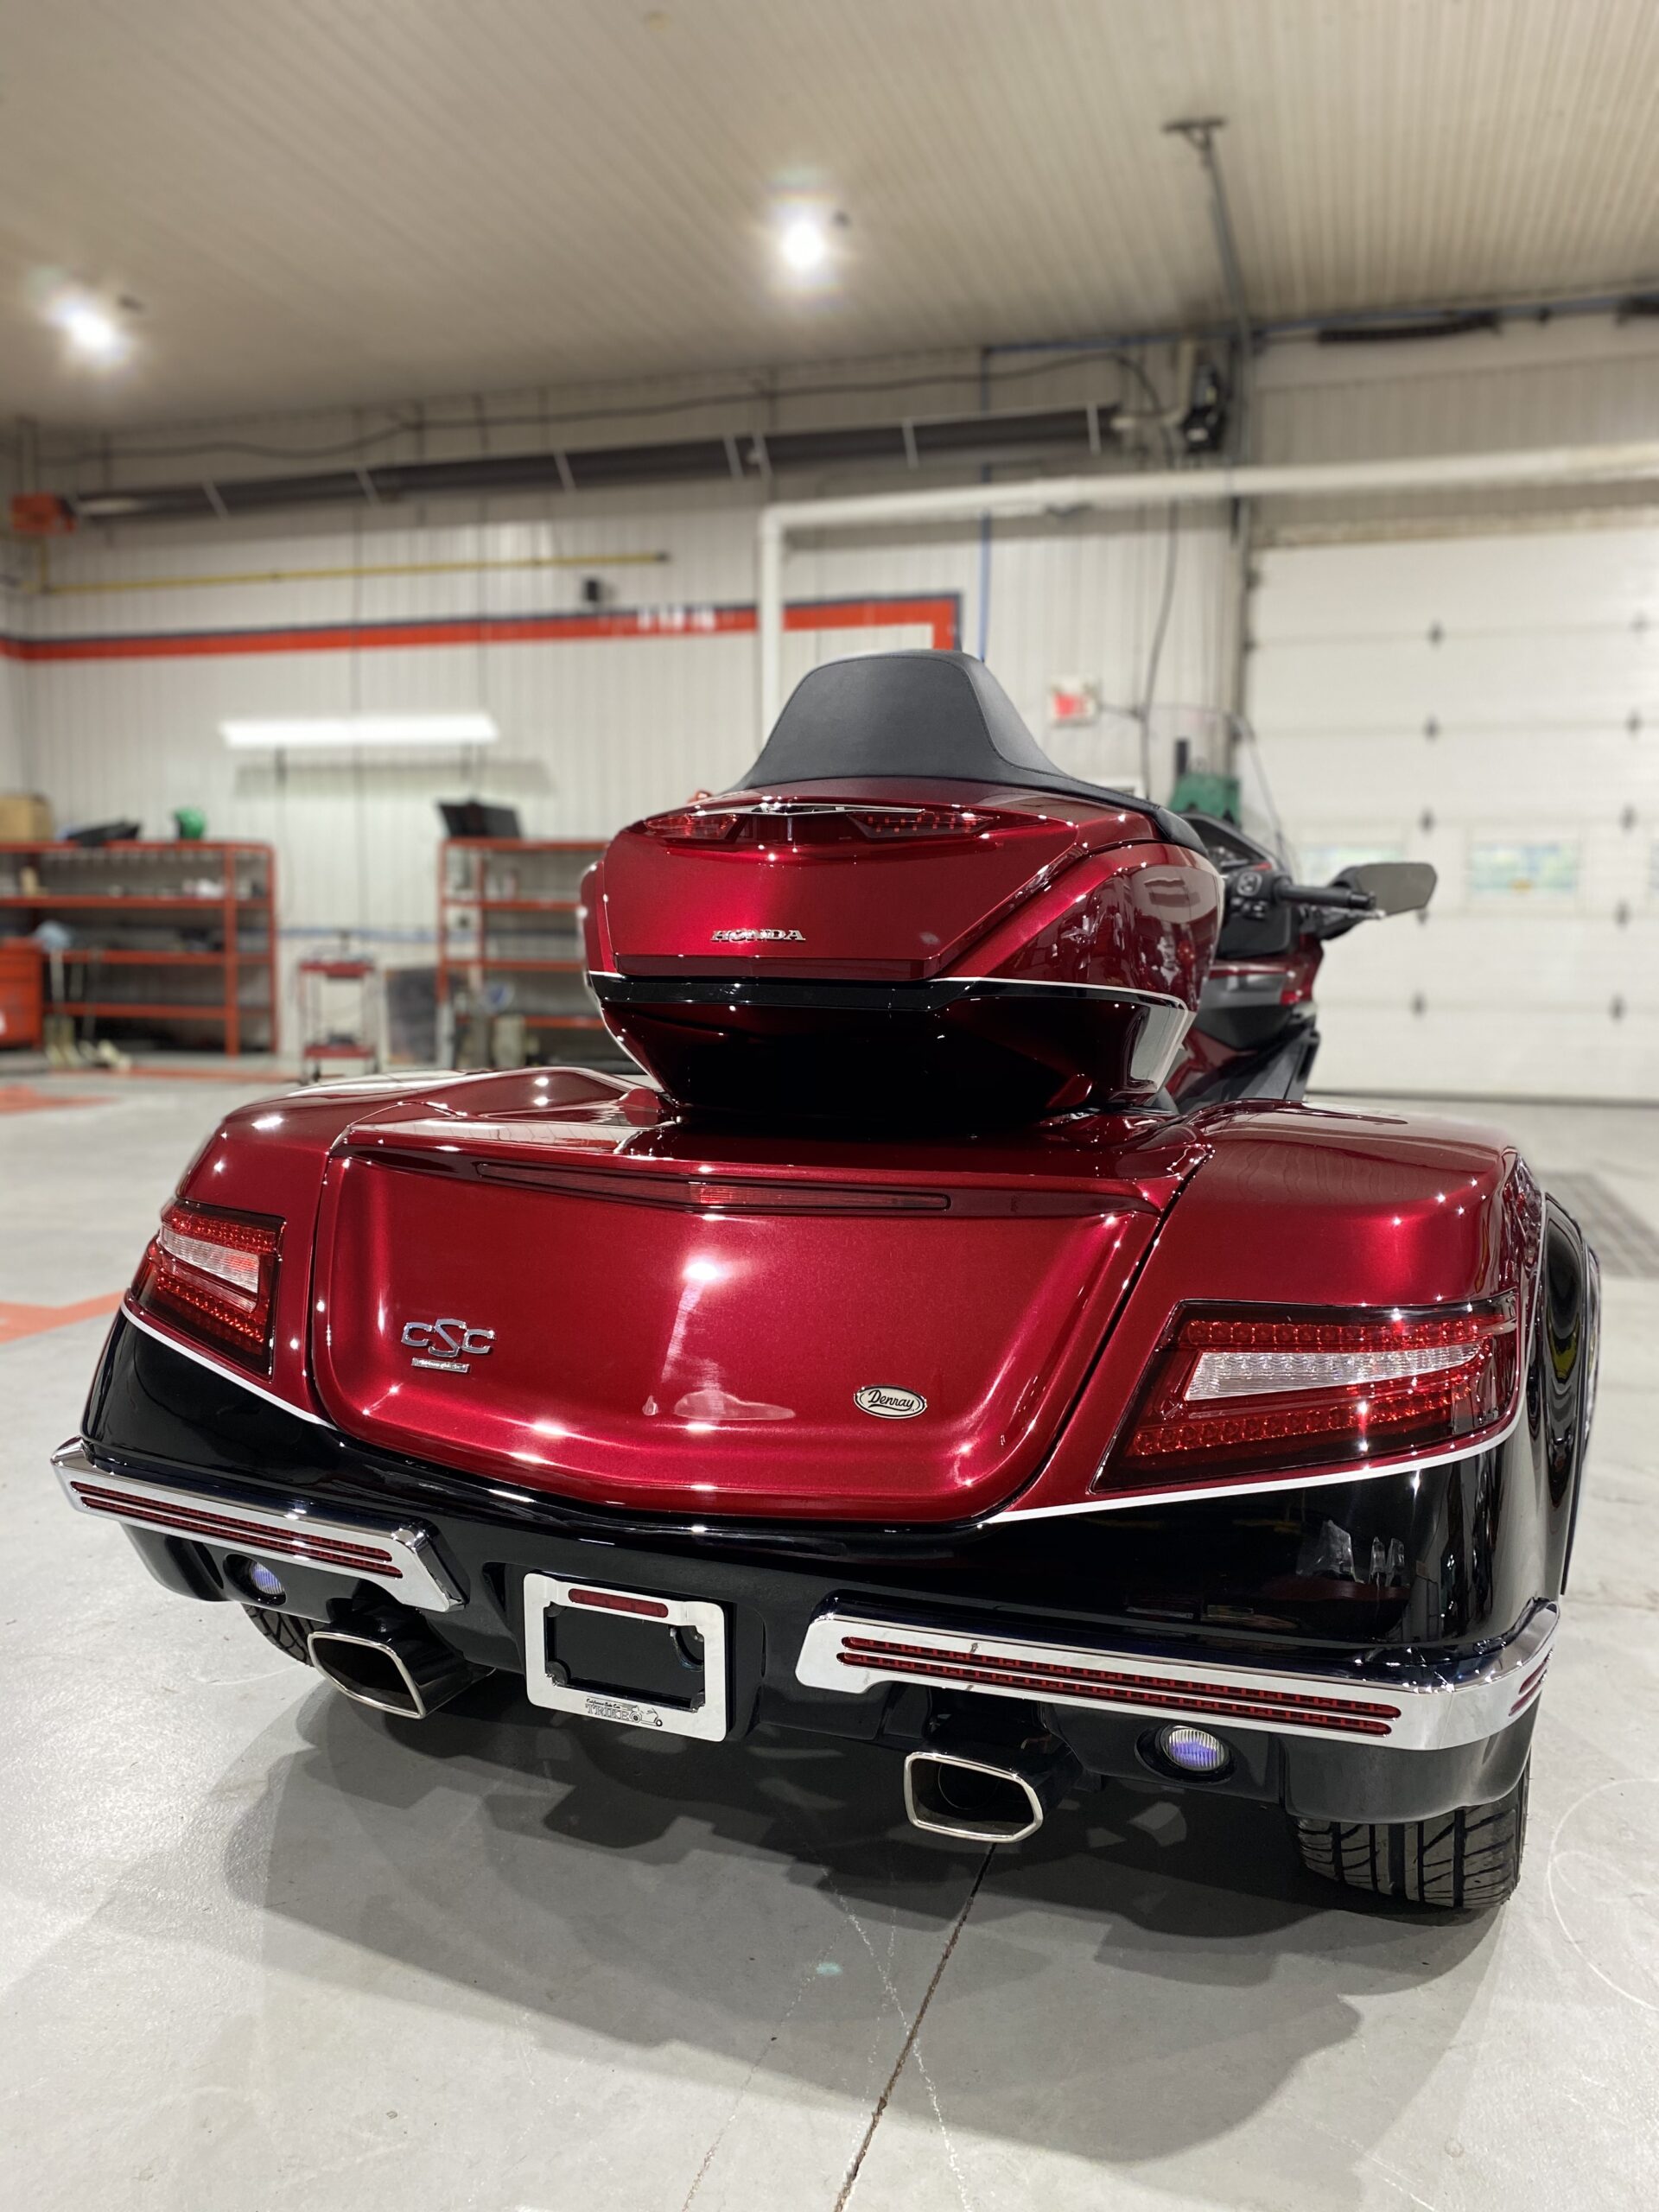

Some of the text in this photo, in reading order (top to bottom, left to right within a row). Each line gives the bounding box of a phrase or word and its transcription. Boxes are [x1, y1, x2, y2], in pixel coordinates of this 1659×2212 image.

[711, 929, 806, 943] HONDA
[401, 1319, 496, 1357] CSC
[868, 1389, 914, 1411] Denray
[585, 1703, 631, 1721] TRIKE
